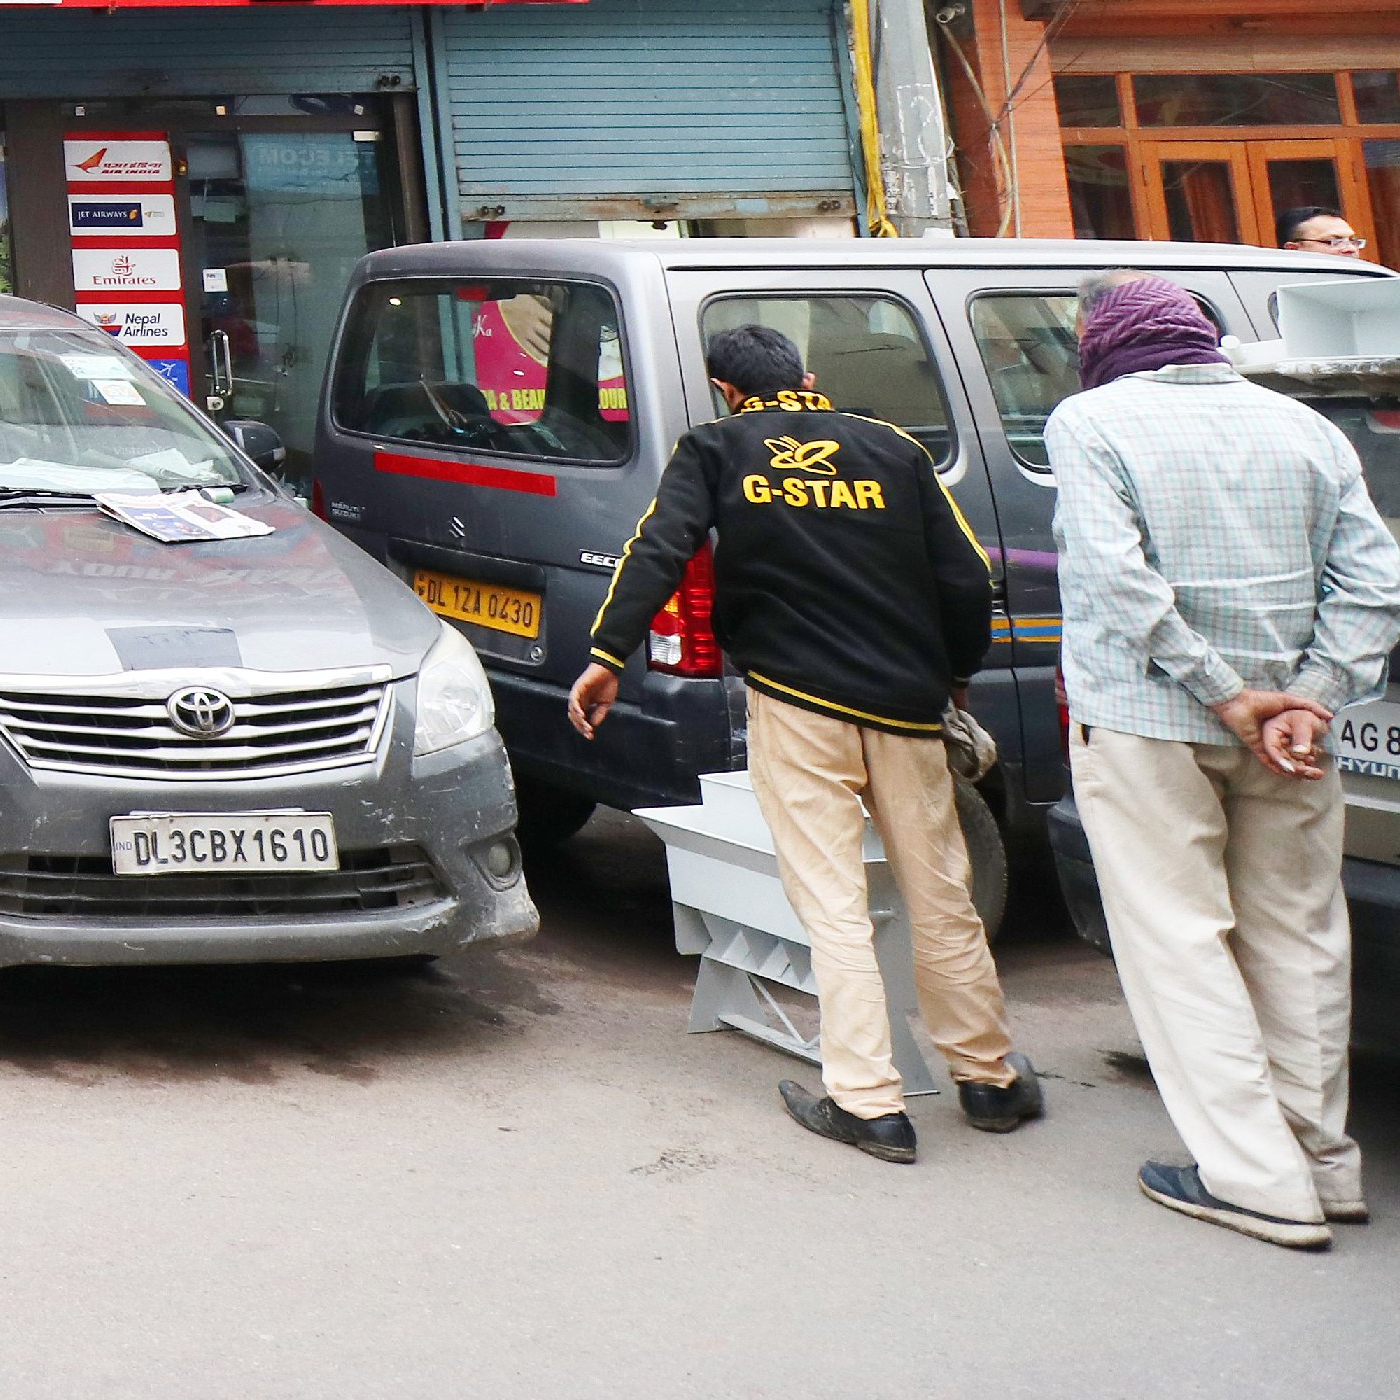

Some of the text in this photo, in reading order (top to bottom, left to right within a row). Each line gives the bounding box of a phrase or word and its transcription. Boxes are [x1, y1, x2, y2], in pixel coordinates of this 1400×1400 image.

[92, 210, 128, 219] AIRWAYS
[92, 275, 156, 286] Emirates
[124, 313, 161, 328] Nepal
[123, 326, 168, 337] Airlines
[742, 474, 886, 510] G-STAR
[427, 578, 446, 607] DL
[133, 828, 330, 867] DL3CBX1610
